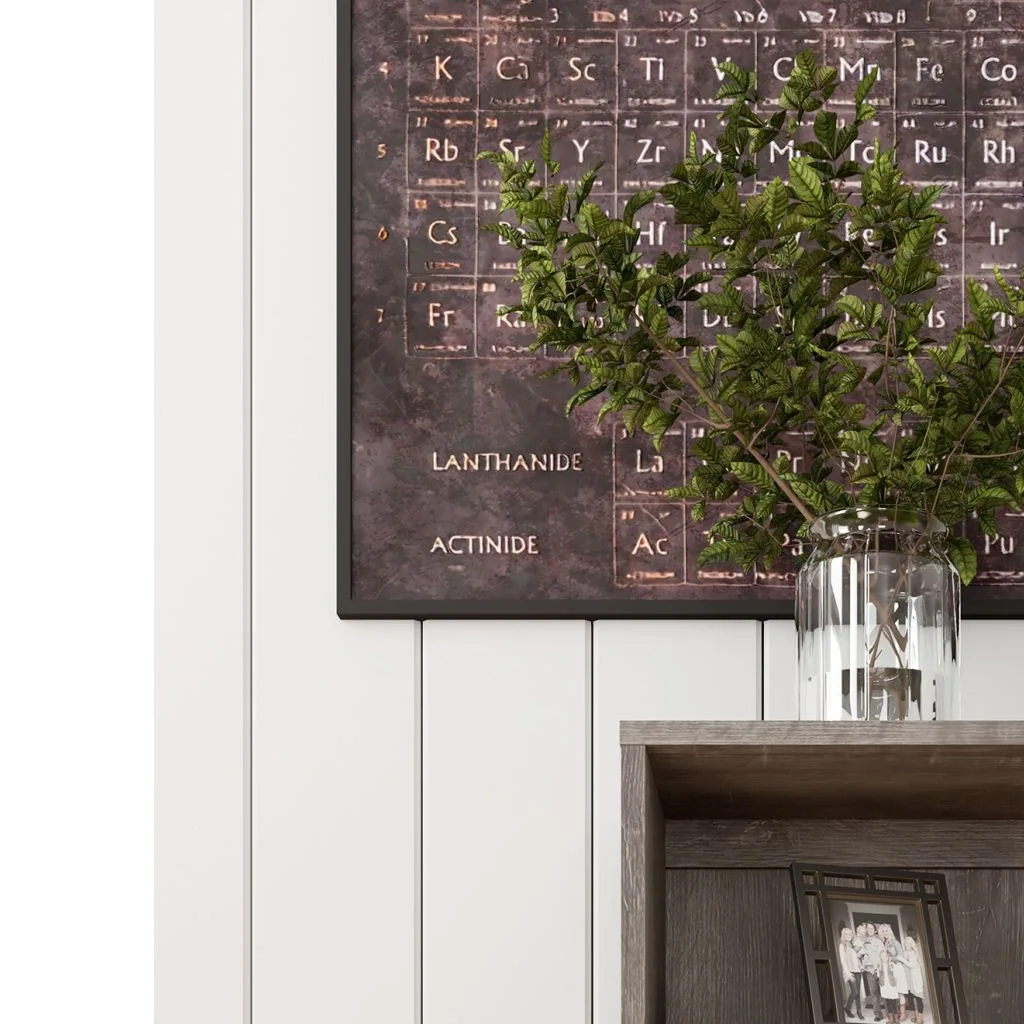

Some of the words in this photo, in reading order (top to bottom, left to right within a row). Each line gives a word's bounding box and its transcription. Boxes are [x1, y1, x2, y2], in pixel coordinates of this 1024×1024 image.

[435, 56, 453, 80] K
[497, 56, 529, 80] Ca
[570, 57, 596, 81] Sc
[915, 57, 944, 81] Fe
[981, 57, 1018, 82] Co
[377, 143, 388, 159] 5
[425, 137, 459, 162] Rb
[573, 139, 591, 163] Y
[637, 139, 667, 163] Zr
[915, 140, 947, 163] Ru
[983, 140, 1015, 164] Rh
[378, 225, 389, 241] 6
[428, 220, 458, 245] Cs
[635, 220, 668, 246] Hf
[990, 221, 1010, 246] Ir
[428, 303, 455, 327] Fr
[431, 452, 584, 472] LANTHANIDE
[636, 449, 664, 473] La
[430, 536, 540, 555] ACTINIDE
[631, 533, 668, 556] Ac
